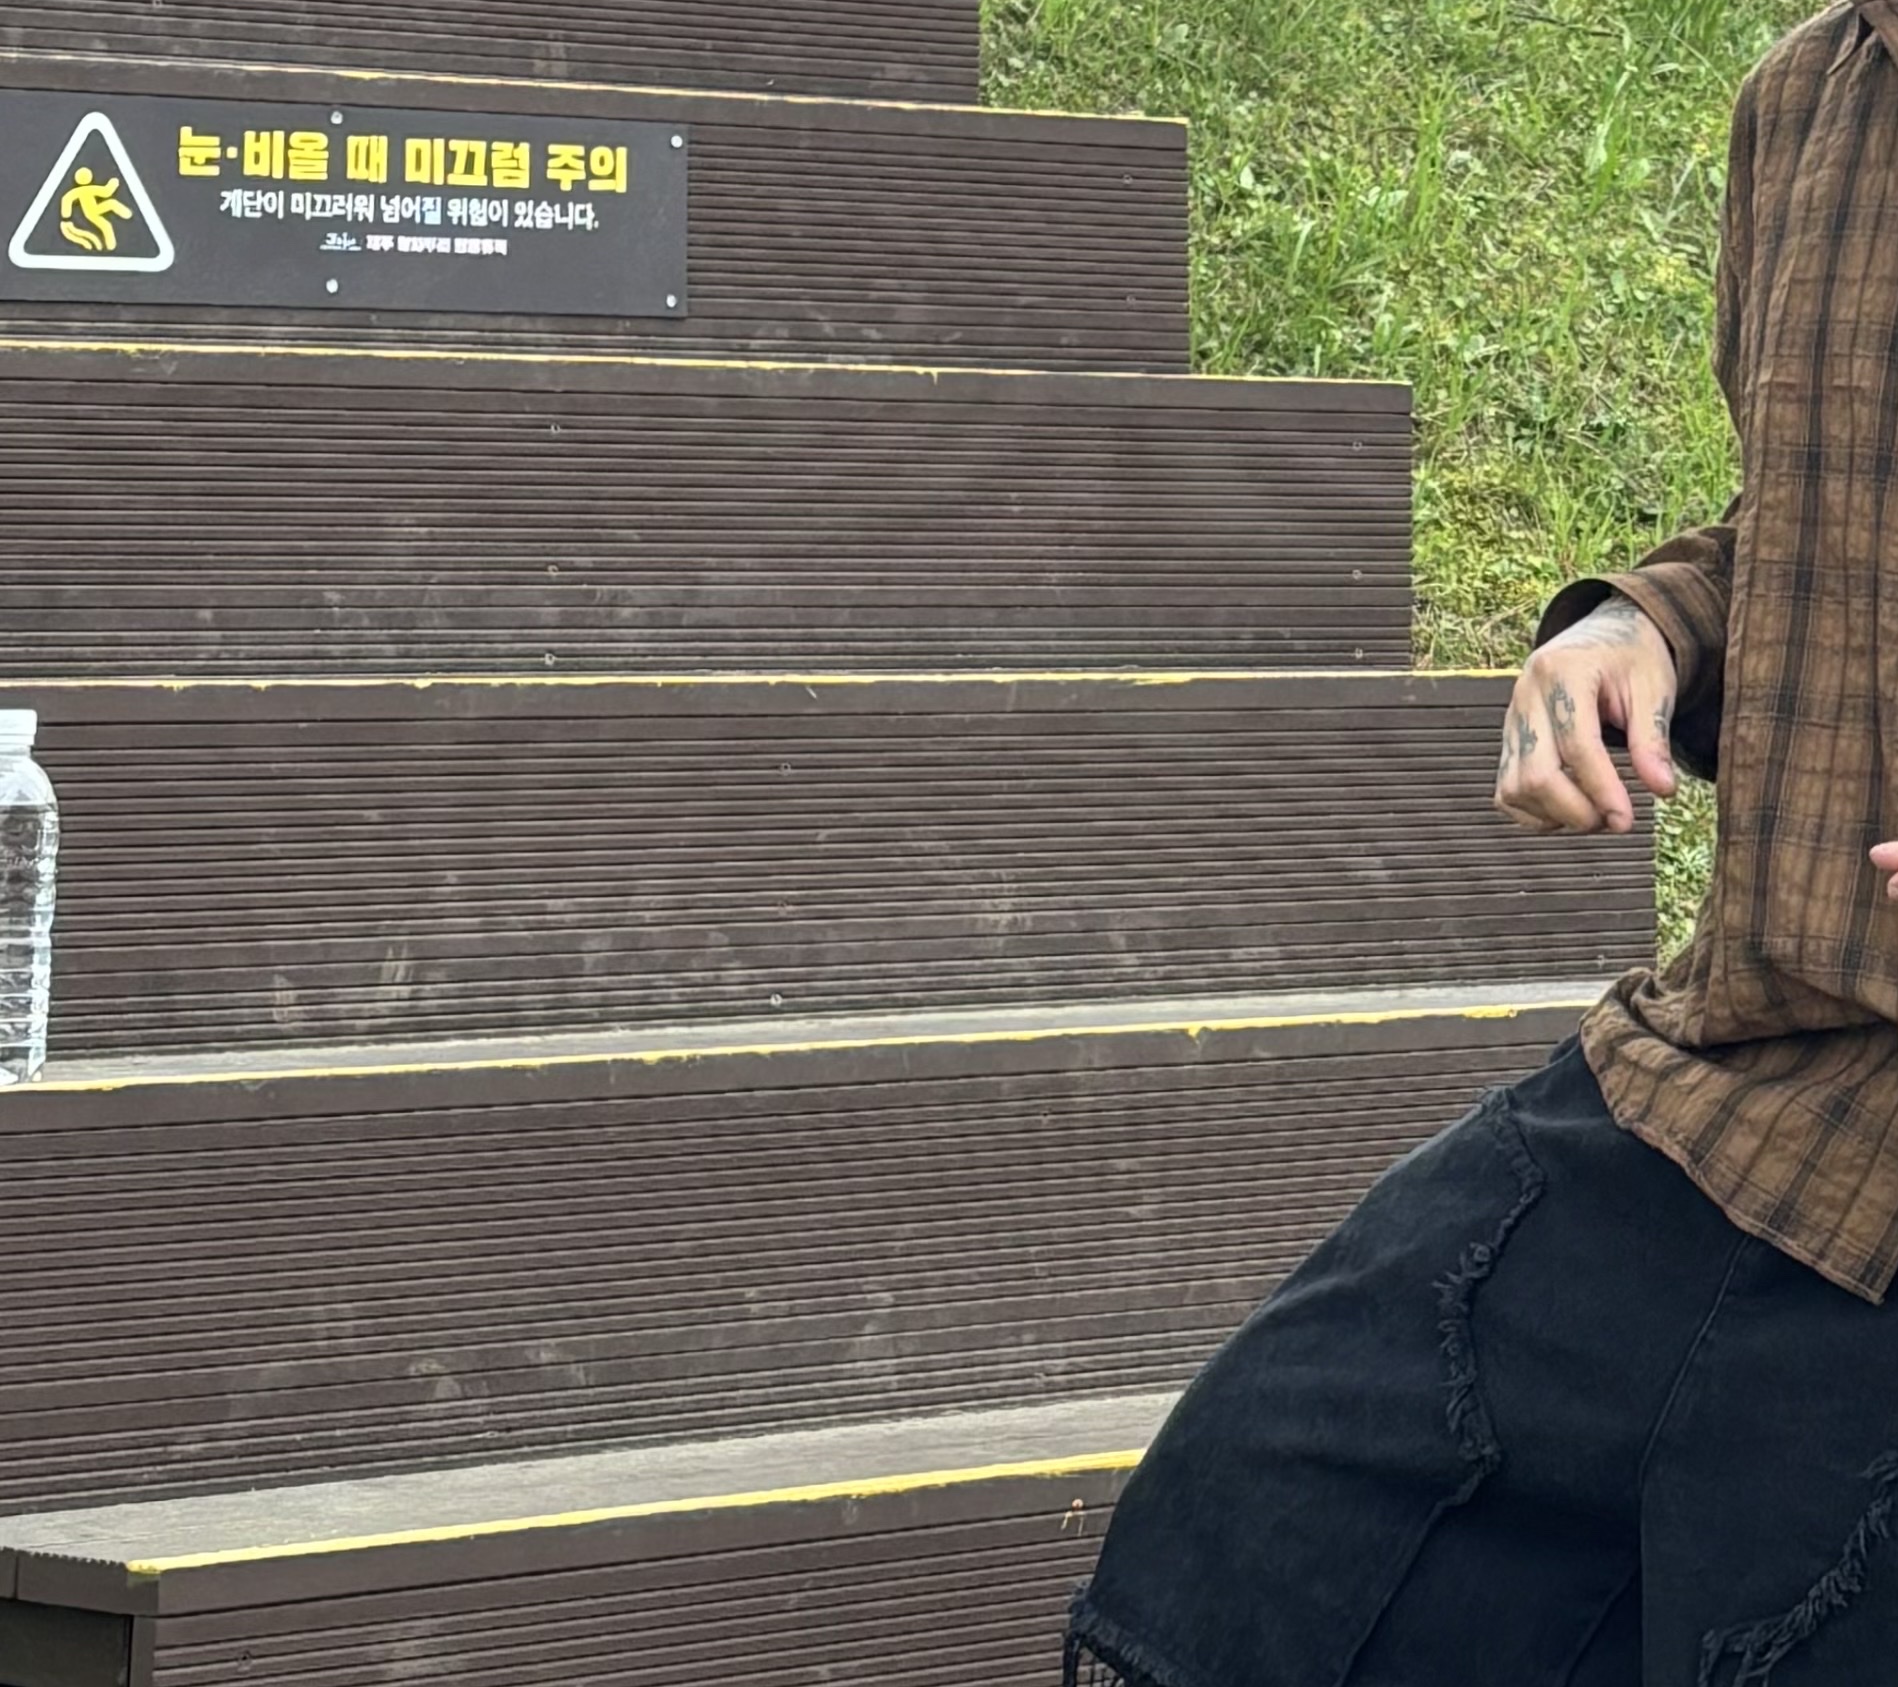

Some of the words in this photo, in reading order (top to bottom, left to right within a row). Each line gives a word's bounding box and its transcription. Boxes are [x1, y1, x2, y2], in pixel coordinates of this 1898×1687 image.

[346, 135, 388, 183] 때
[404, 138, 530, 189] 미끄럼
[546, 144, 628, 193] 주의
[219, 188, 284, 220] 계단이
[290, 191, 375, 223] 미끄러워
[380, 194, 442, 225] 넘어질
[447, 197, 508, 227] 위험이
[514, 200, 599, 230] 있습니다.
